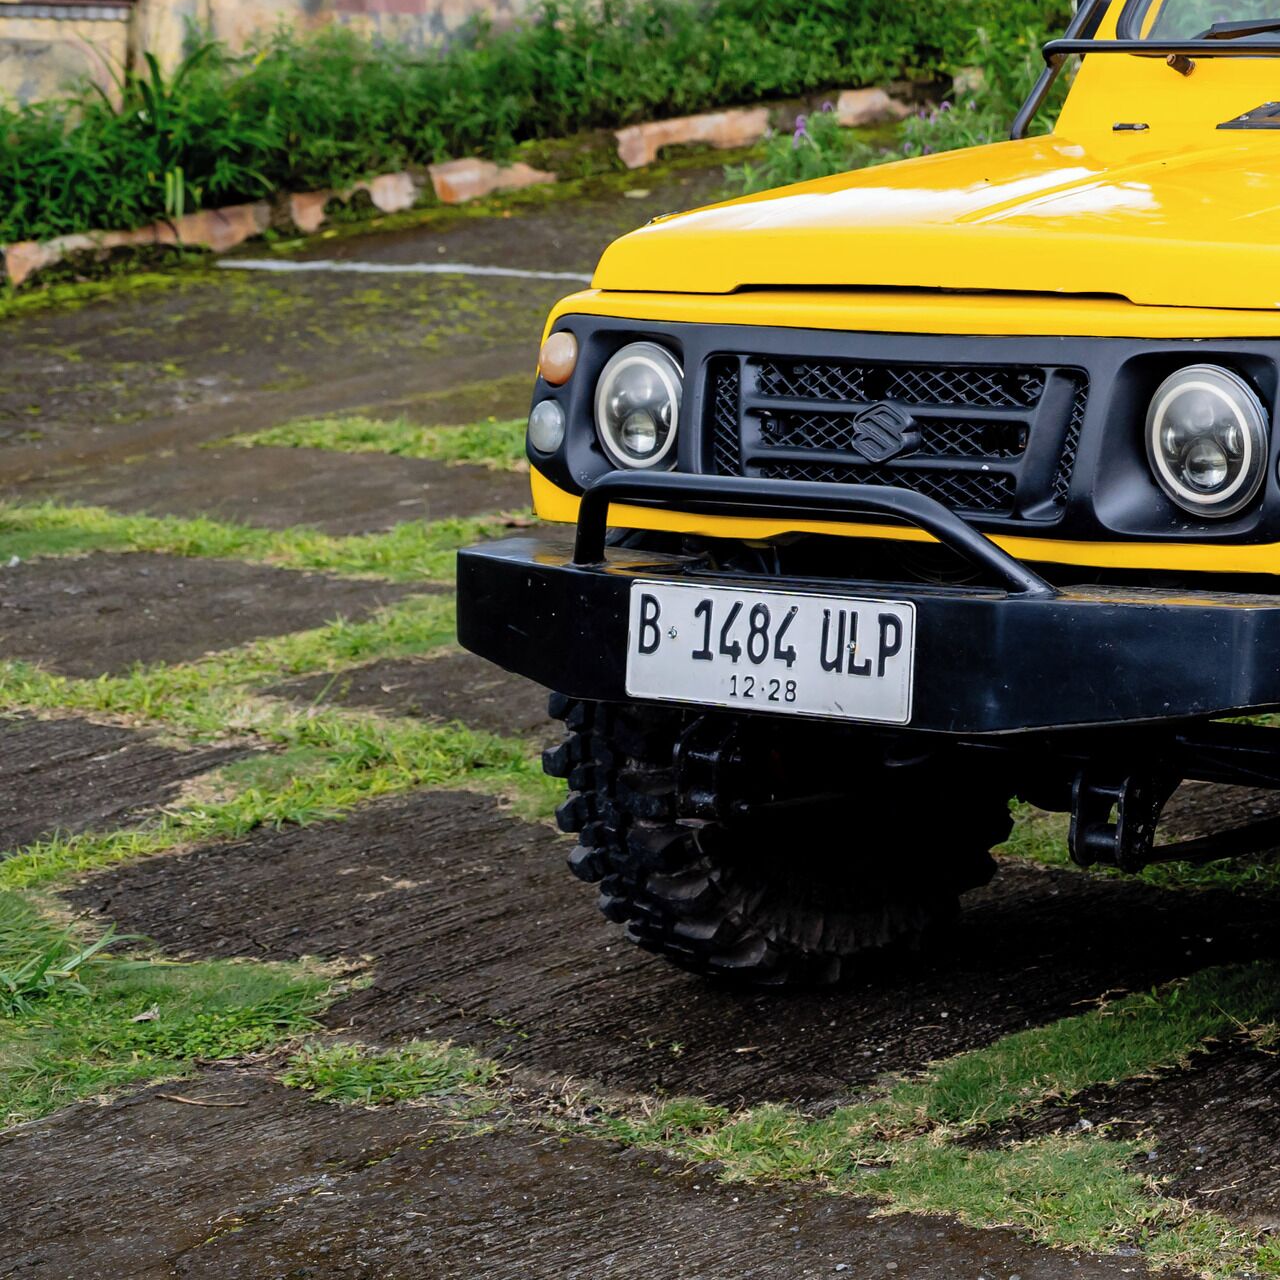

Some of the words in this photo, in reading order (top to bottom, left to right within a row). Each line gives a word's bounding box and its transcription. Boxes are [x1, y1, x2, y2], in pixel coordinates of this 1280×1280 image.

[638, 593, 661, 654] B
[692, 598, 798, 668] 1484
[820, 608, 903, 677] ULP
